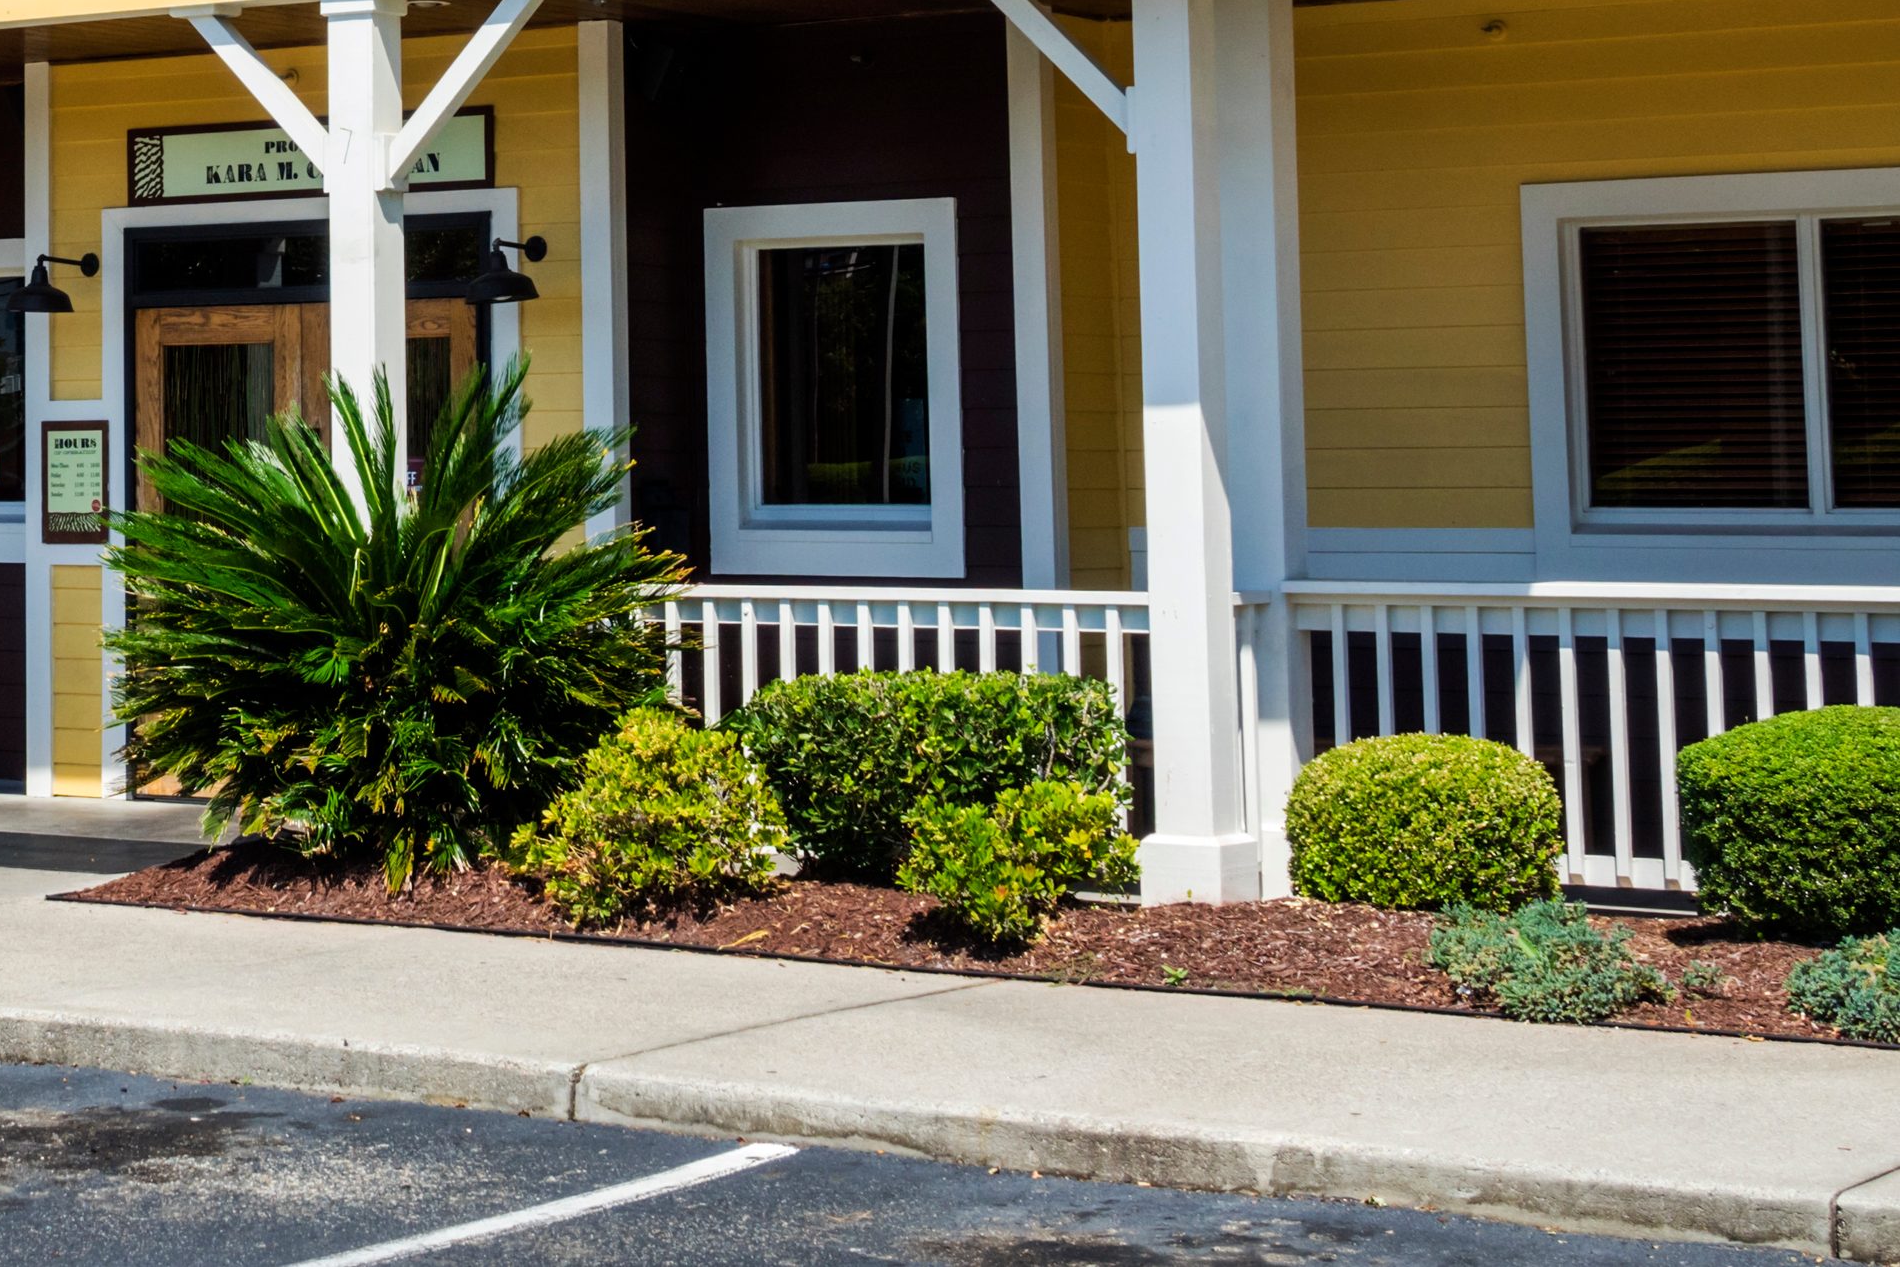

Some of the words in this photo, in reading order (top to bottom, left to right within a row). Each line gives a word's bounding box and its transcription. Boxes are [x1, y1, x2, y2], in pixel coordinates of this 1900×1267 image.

[206, 162, 267, 184] KARA
[277, 161, 299, 181] M.
[54, 437, 97, 449] HOURS
